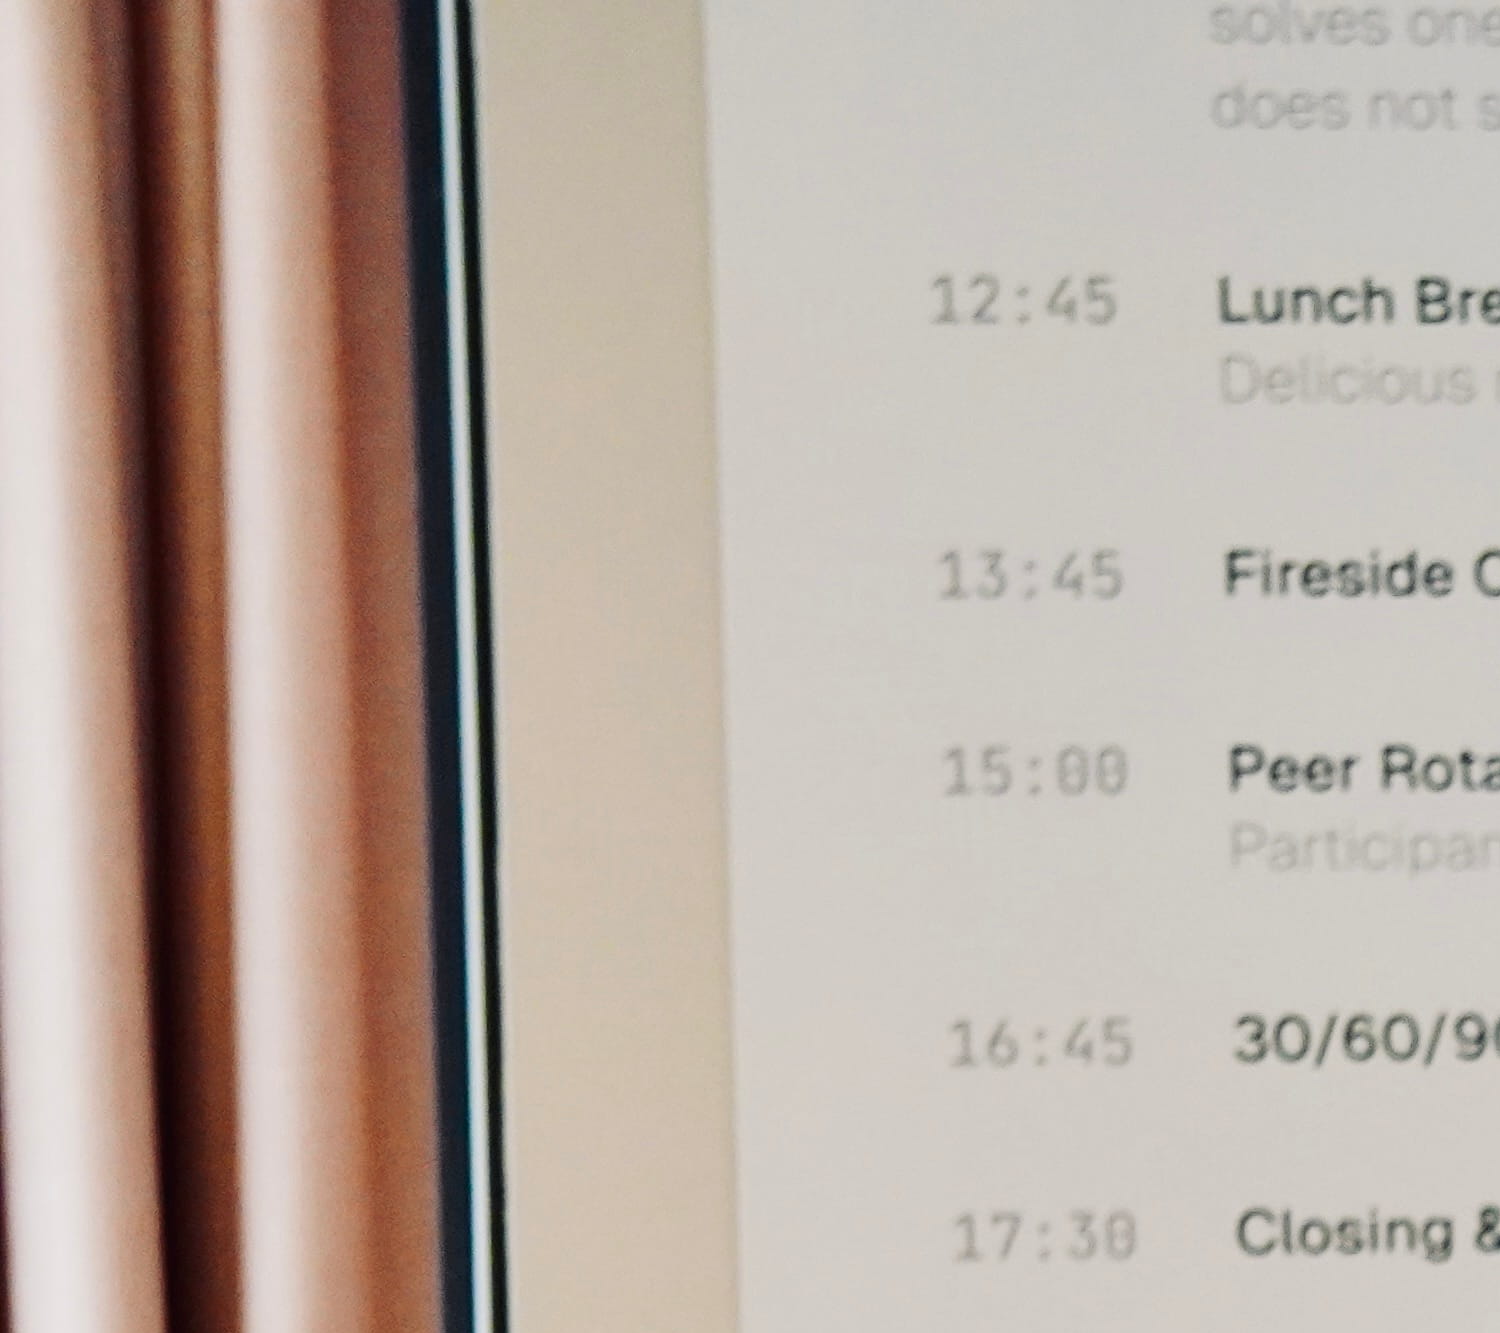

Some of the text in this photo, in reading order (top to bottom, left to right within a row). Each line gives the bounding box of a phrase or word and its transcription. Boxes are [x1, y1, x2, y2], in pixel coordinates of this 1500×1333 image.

[1209, 0, 1392, 47] solves
[1209, 82, 1352, 132] does
[1367, 86, 1458, 132] not
[931, 272, 1118, 326] 12:45
[1218, 276, 1395, 325] Lunch
[1218, 351, 1478, 406] Delicious
[938, 547, 1125, 601] 13:45
[1224, 547, 1455, 598] Fireside
[942, 743, 1129, 797] 15:00
[1228, 743, 1359, 793] Peer
[949, 1015, 1134, 1069] 16:45
[953, 1208, 1138, 1264] 17:30
[1235, 1205, 1455, 1264] Closing
